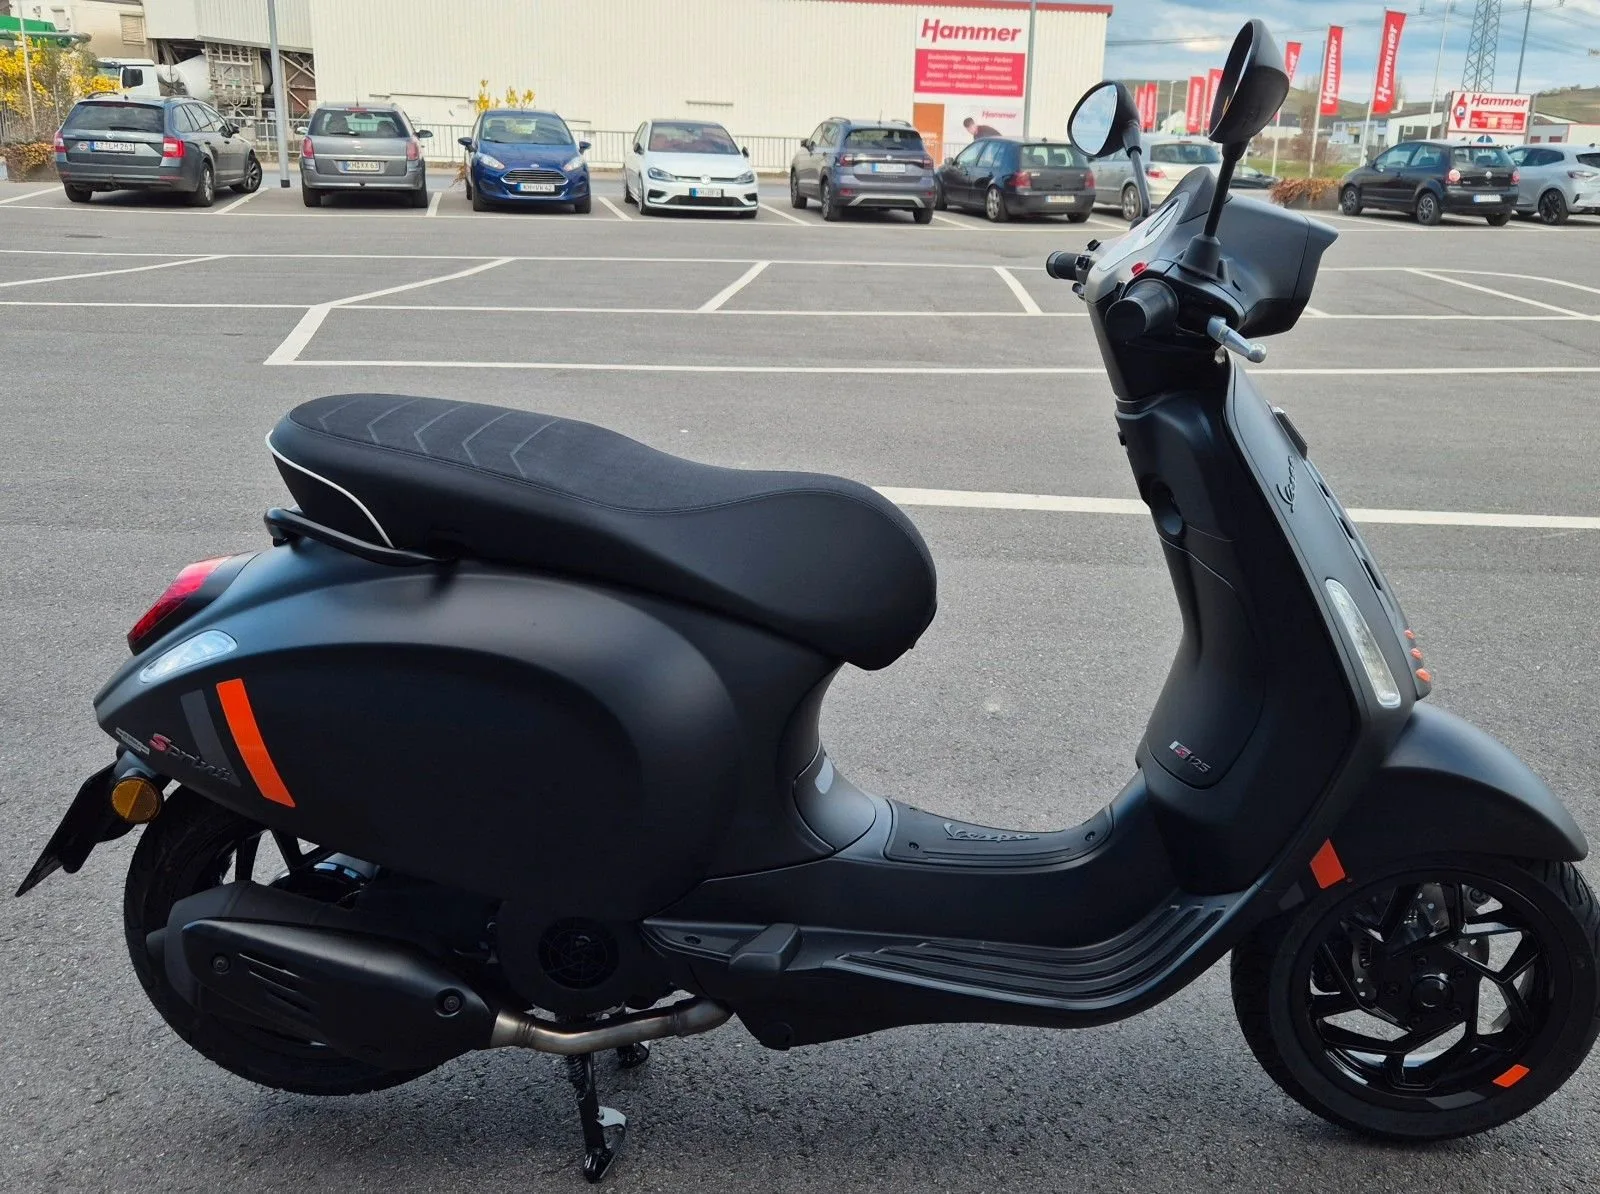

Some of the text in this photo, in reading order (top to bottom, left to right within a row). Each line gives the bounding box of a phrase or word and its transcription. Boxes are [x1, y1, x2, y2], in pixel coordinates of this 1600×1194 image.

[921, 18, 1022, 43] Hammer
[1322, 35, 1338, 105] Hammer
[1376, 23, 1398, 102] Hammer
[1471, 94, 1528, 107] Hammer
[981, 110, 1017, 119] Hammer
[1188, 755, 1211, 773] 125
[943, 822, 1040, 843] Vespa
